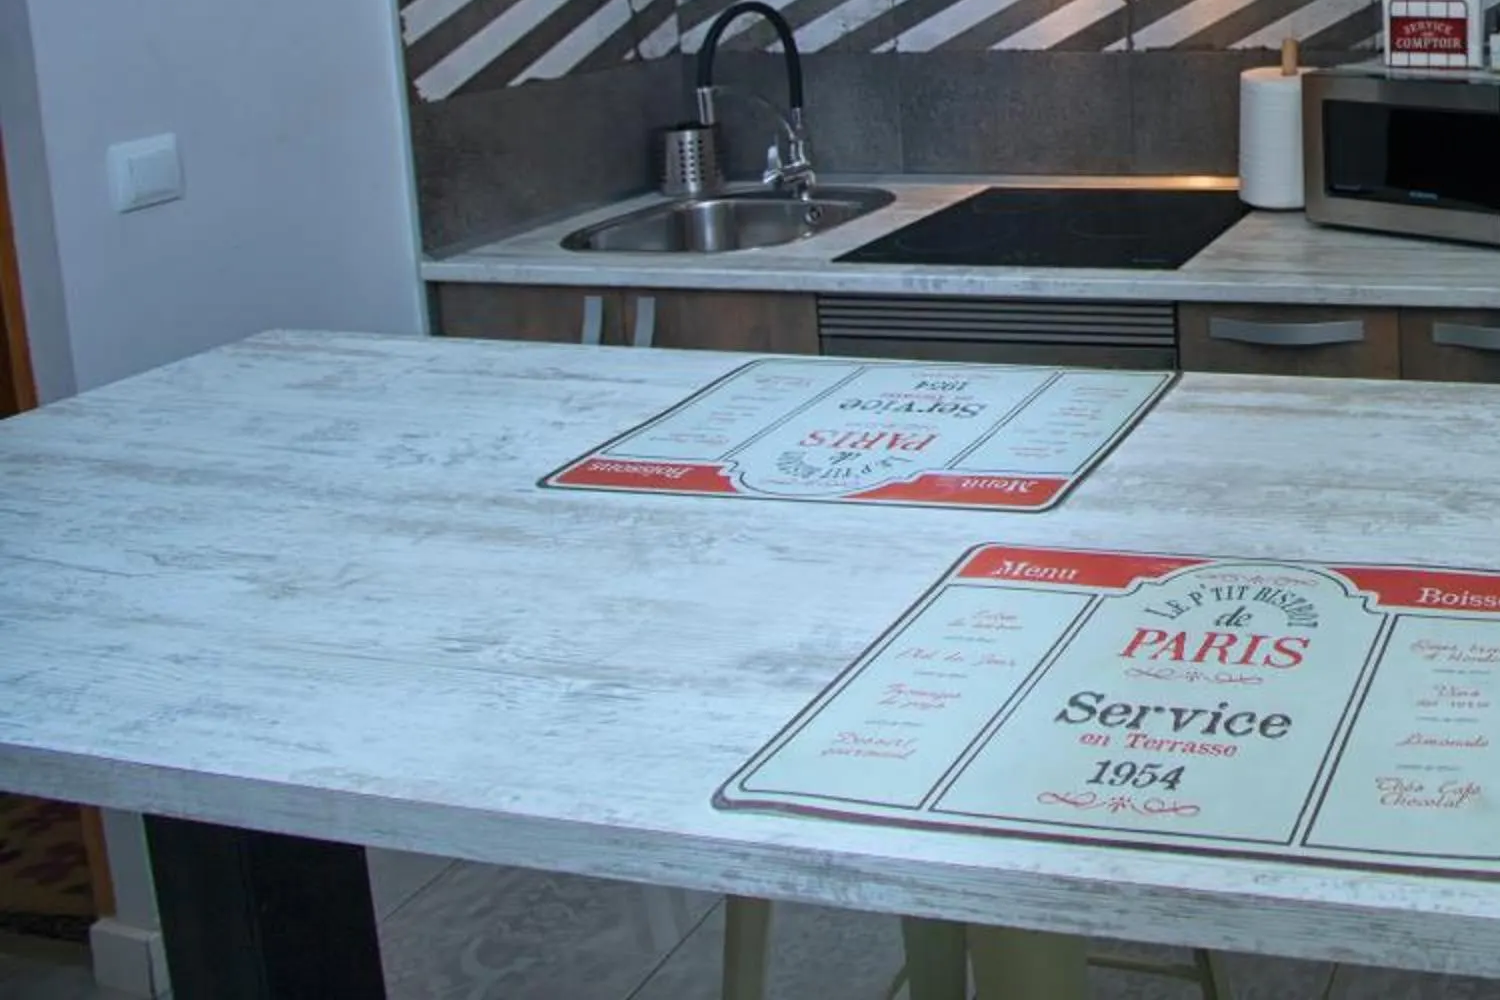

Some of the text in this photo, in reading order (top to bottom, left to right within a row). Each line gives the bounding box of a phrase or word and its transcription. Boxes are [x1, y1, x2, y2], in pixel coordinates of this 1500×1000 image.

[1403, 21, 1453, 35] SERVICE
[1395, 37, 1462, 49] COMPTOIR
[839, 399, 988, 419] Service
[799, 430, 939, 450] PARIS
[992, 560, 1078, 579] Menu
[1144, 599, 1190, 620] LE
[1214, 605, 1254, 628] de
[1117, 627, 1310, 669] PARIS
[1054, 690, 1293, 739] Service
[1079, 732, 1239, 757] en Terrasse
[1086, 759, 1186, 791] 1954
